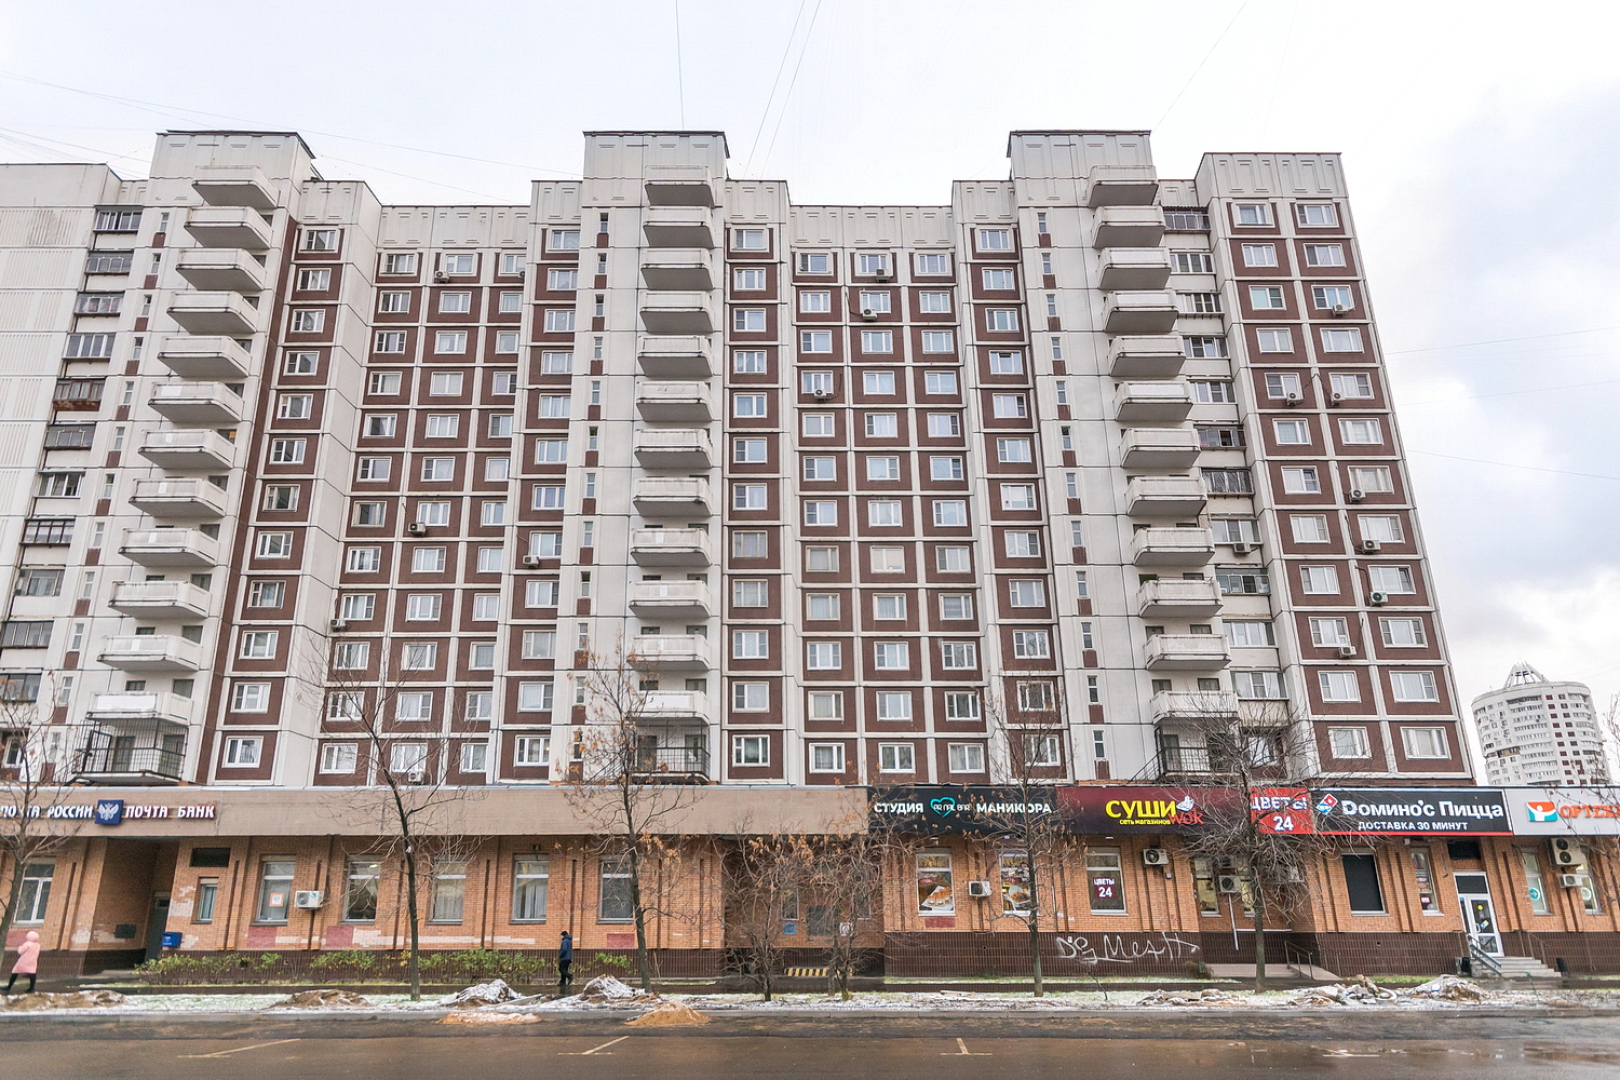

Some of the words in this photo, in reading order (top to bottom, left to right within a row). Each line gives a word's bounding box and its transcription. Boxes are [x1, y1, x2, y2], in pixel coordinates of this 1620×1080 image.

[873, 802, 924, 815] СТУДИЯ
[976, 802, 1052, 814] МАНИКЮРА
[1105, 800, 1177, 819] СУШИ
[1250, 796, 1308, 811] ЦВЕТЫ
[1439, 801, 1504, 820] Пицца
[46, 804, 94, 819] РОССИИ
[124, 804, 169, 819] ПОЧТА
[176, 804, 216, 819] БАНК
[1273, 815, 1295, 832] 24
[1357, 821, 1416, 831] ДОСТАВКА
[1417, 822, 1431, 830] 30
[1432, 822, 1468, 831] МИНУТ
[1097, 886, 1113, 898] 24
